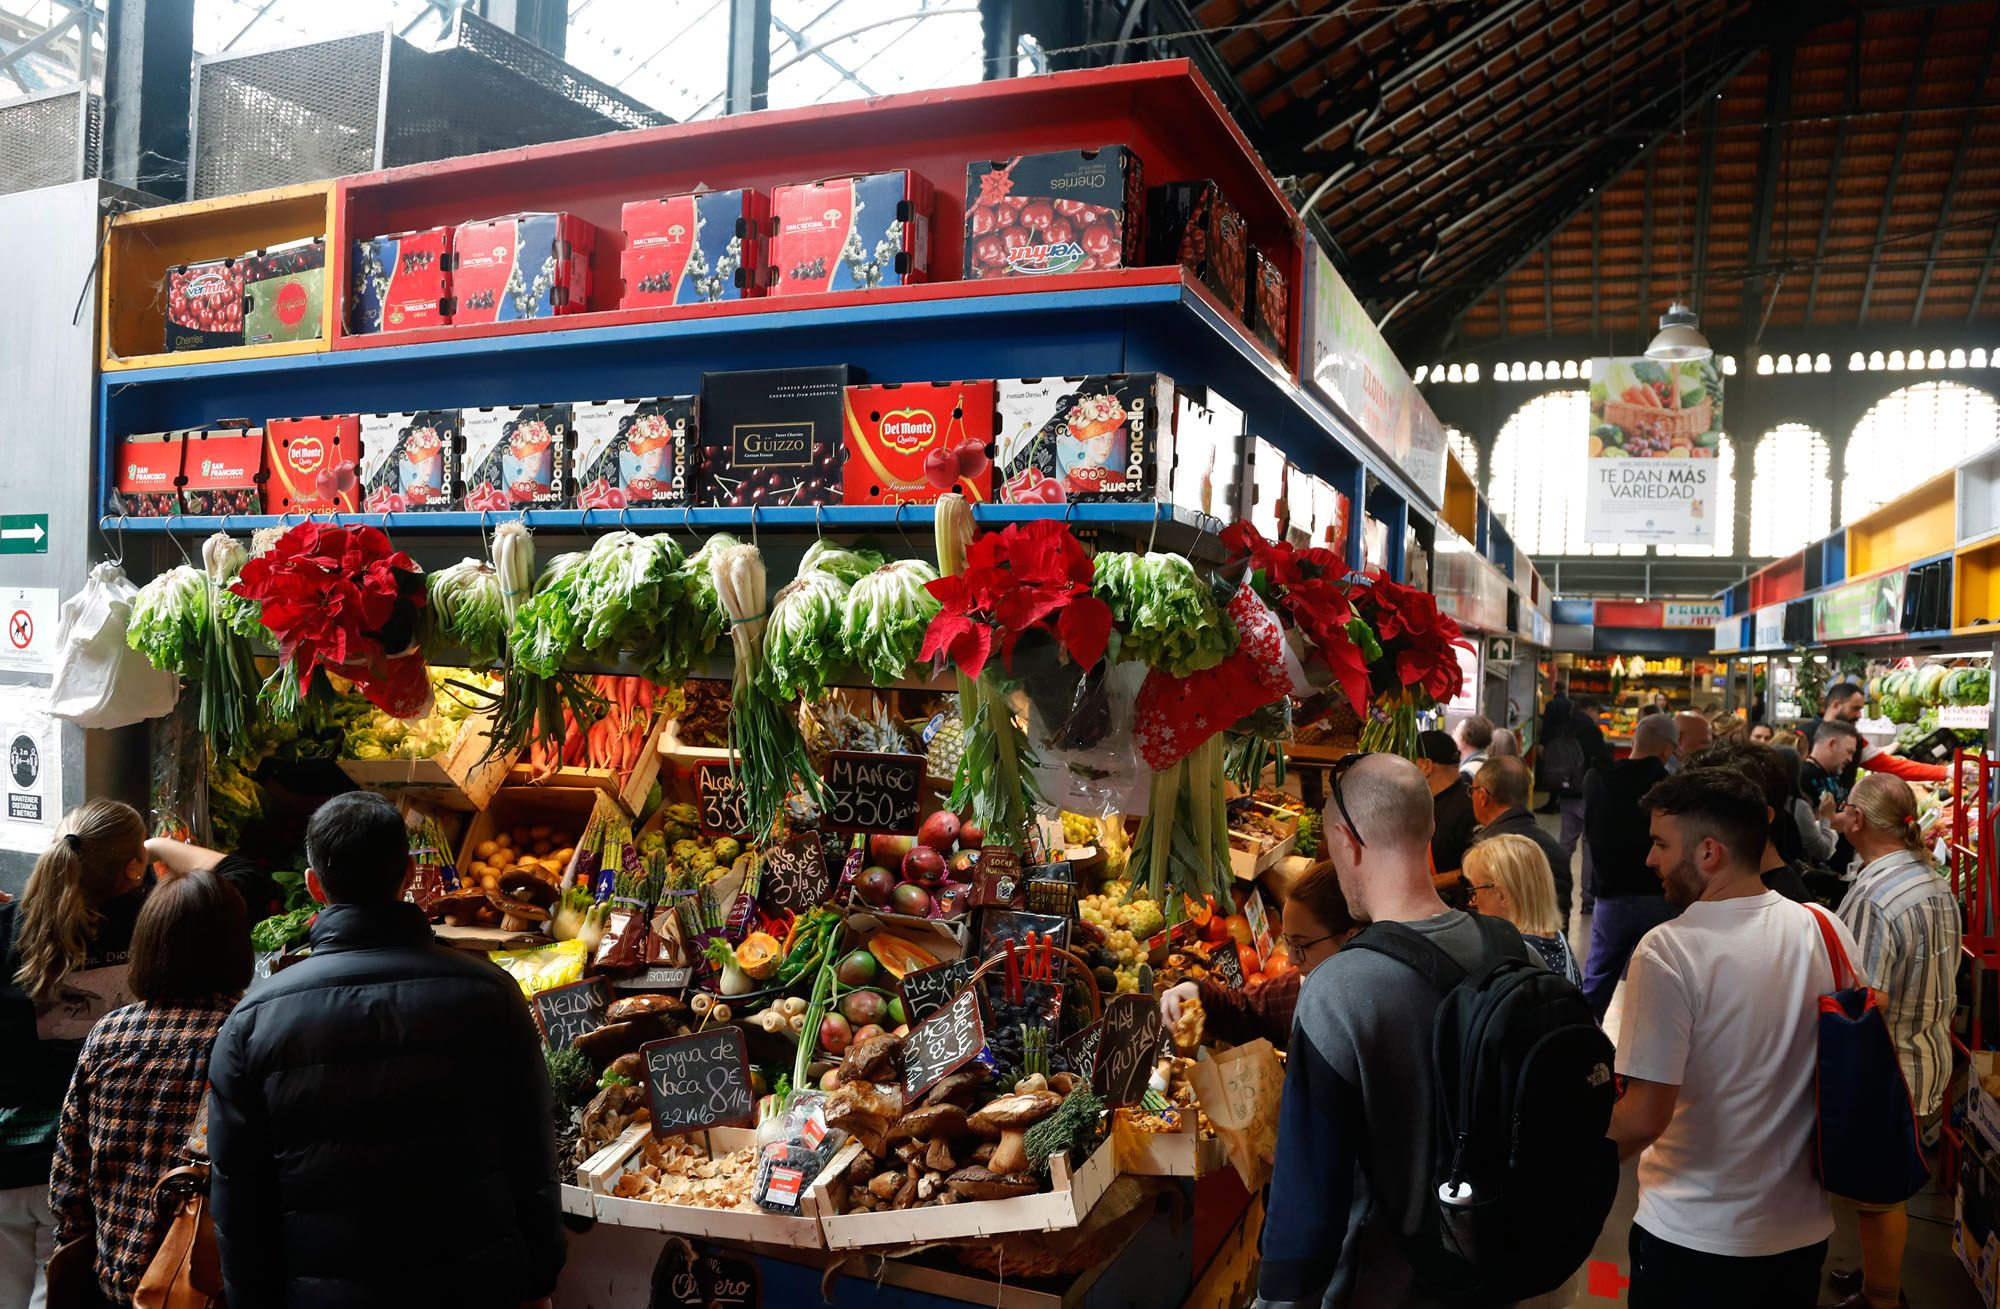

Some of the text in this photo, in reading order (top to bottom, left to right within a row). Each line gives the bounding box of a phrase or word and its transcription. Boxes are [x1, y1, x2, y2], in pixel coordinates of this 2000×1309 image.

[1050, 174, 1105, 190] Cherries
[1006, 242, 1084, 264] verfrut
[175, 335, 204, 346] Cherries
[884, 422, 932, 435] Del Monte
[896, 435, 918, 444] Quality
[1126, 397, 1145, 480] Doncella
[291, 447, 321, 458] Del Monte
[551, 423, 564, 492] Doncella
[671, 417, 686, 490] Doncella
[441, 429, 452, 495] Doncella
[136, 473, 166, 481] FRANCISCO
[1600, 464, 1706, 484] TE DAN MÁS
[1099, 479, 1143, 492] Sweet
[1610, 484, 1695, 499] VARIEDAD
[425, 495, 451, 505] Sweet
[532, 491, 562, 502] Sweet
[651, 488, 685, 501] Sweet
[832, 759, 913, 791] MANGO
[11, 794, 38, 803] MANTENER
[11, 802, 37, 810] DISTANCIA
[16, 809, 37, 817] METROS
[645, 971, 684, 982] BOLLO
[538, 984, 604, 1022] MELON
[1106, 1001, 1133, 1035] HAY
[645, 1037, 740, 1078] Lengua de
[1096, 1010, 1154, 1092] TRUFAS
[652, 1073, 704, 1097] Vaca
